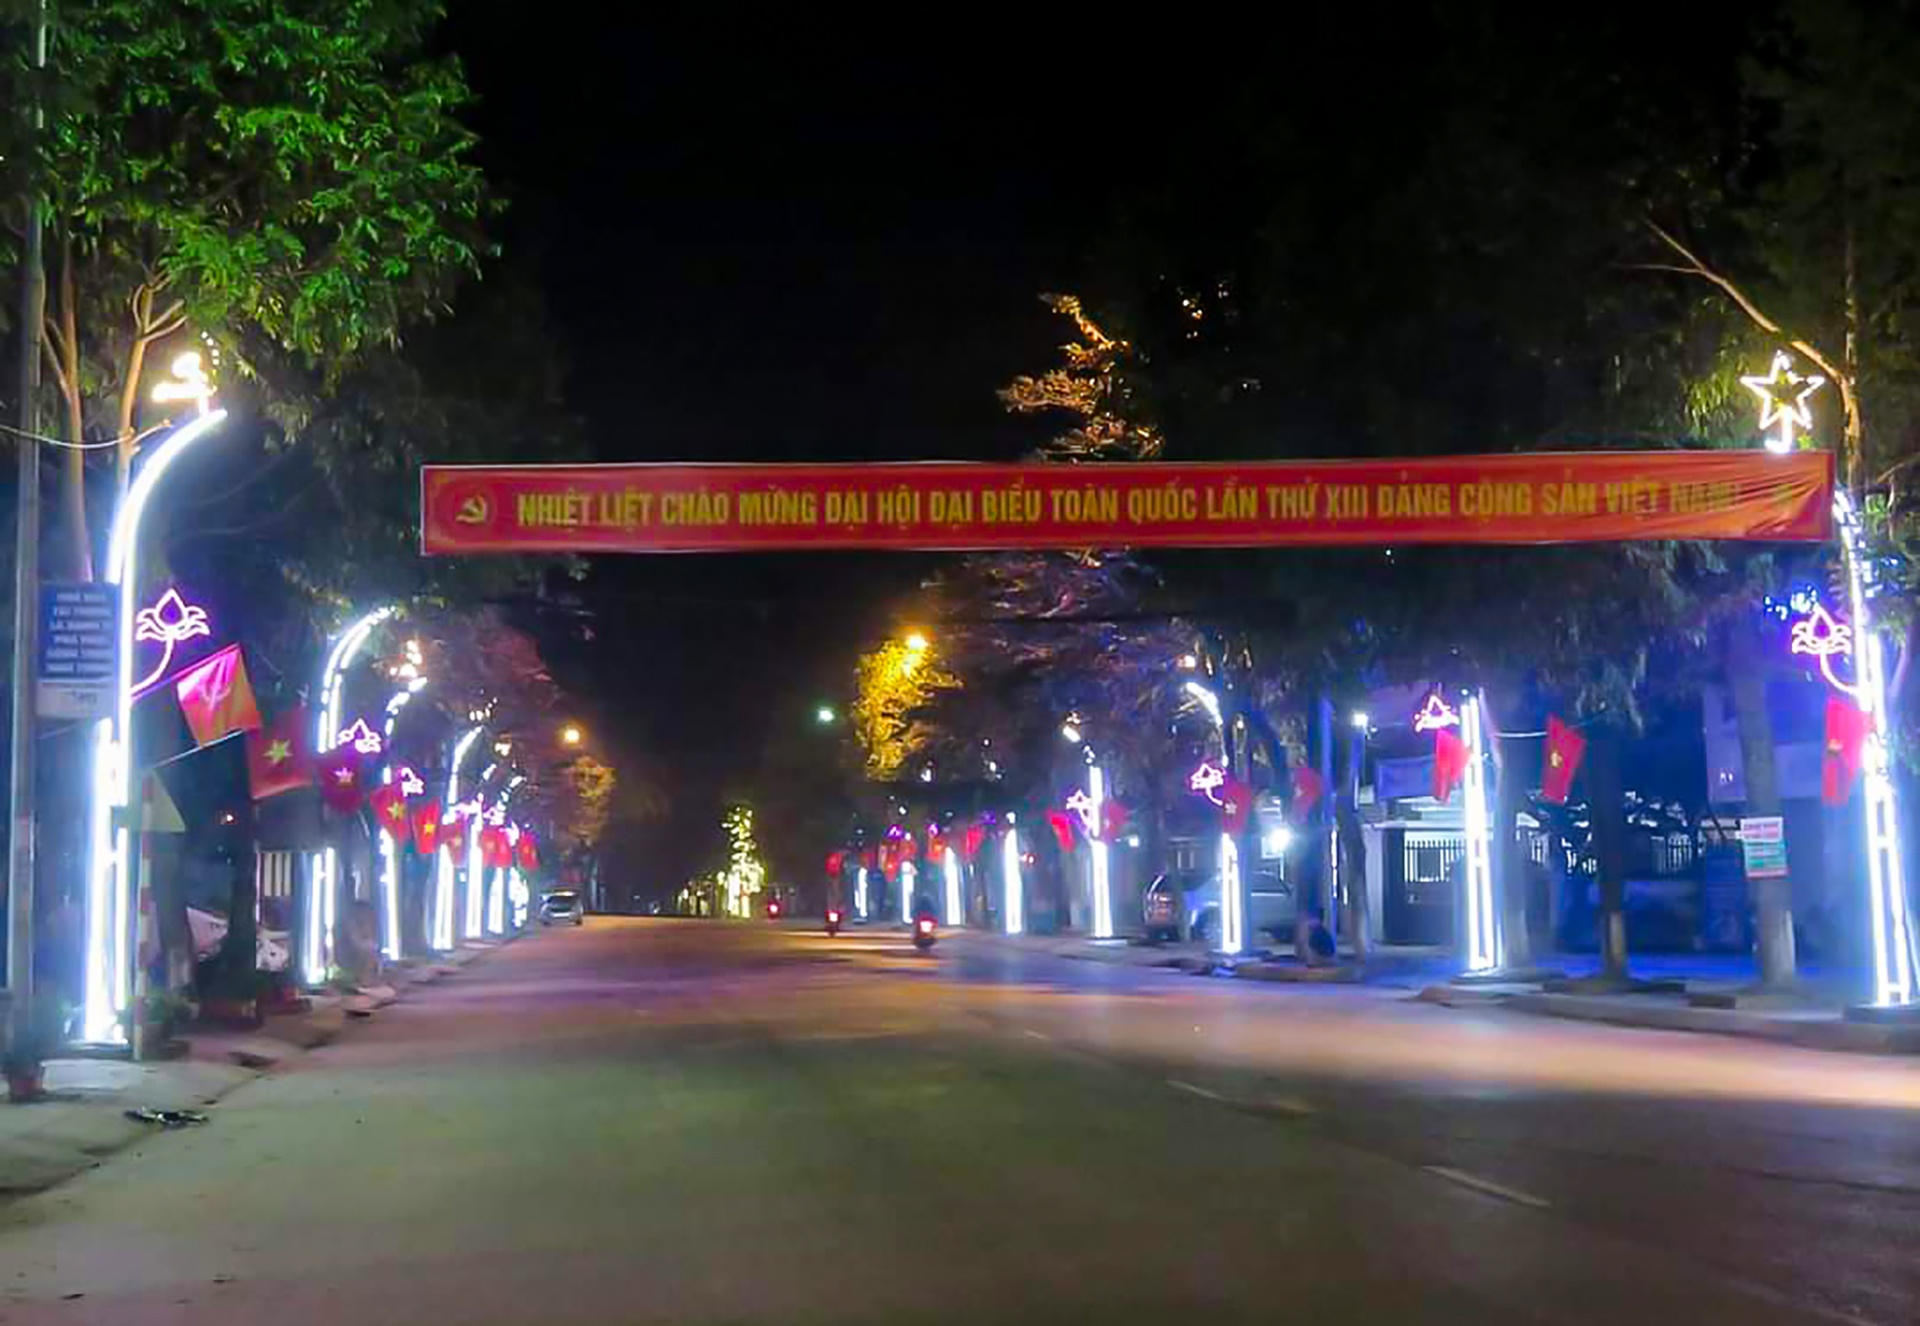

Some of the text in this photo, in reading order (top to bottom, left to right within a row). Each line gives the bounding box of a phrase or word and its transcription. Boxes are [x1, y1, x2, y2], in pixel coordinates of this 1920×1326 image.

[517, 486, 591, 532] NHIỆT
[599, 485, 653, 531] LIỆT
[877, 483, 920, 531] HỘI
[1049, 483, 1118, 521] TOÀN
[1128, 476, 1198, 525] QUỐC
[1325, 483, 1368, 520] XIII
[1605, 476, 1661, 519] VIỆT
